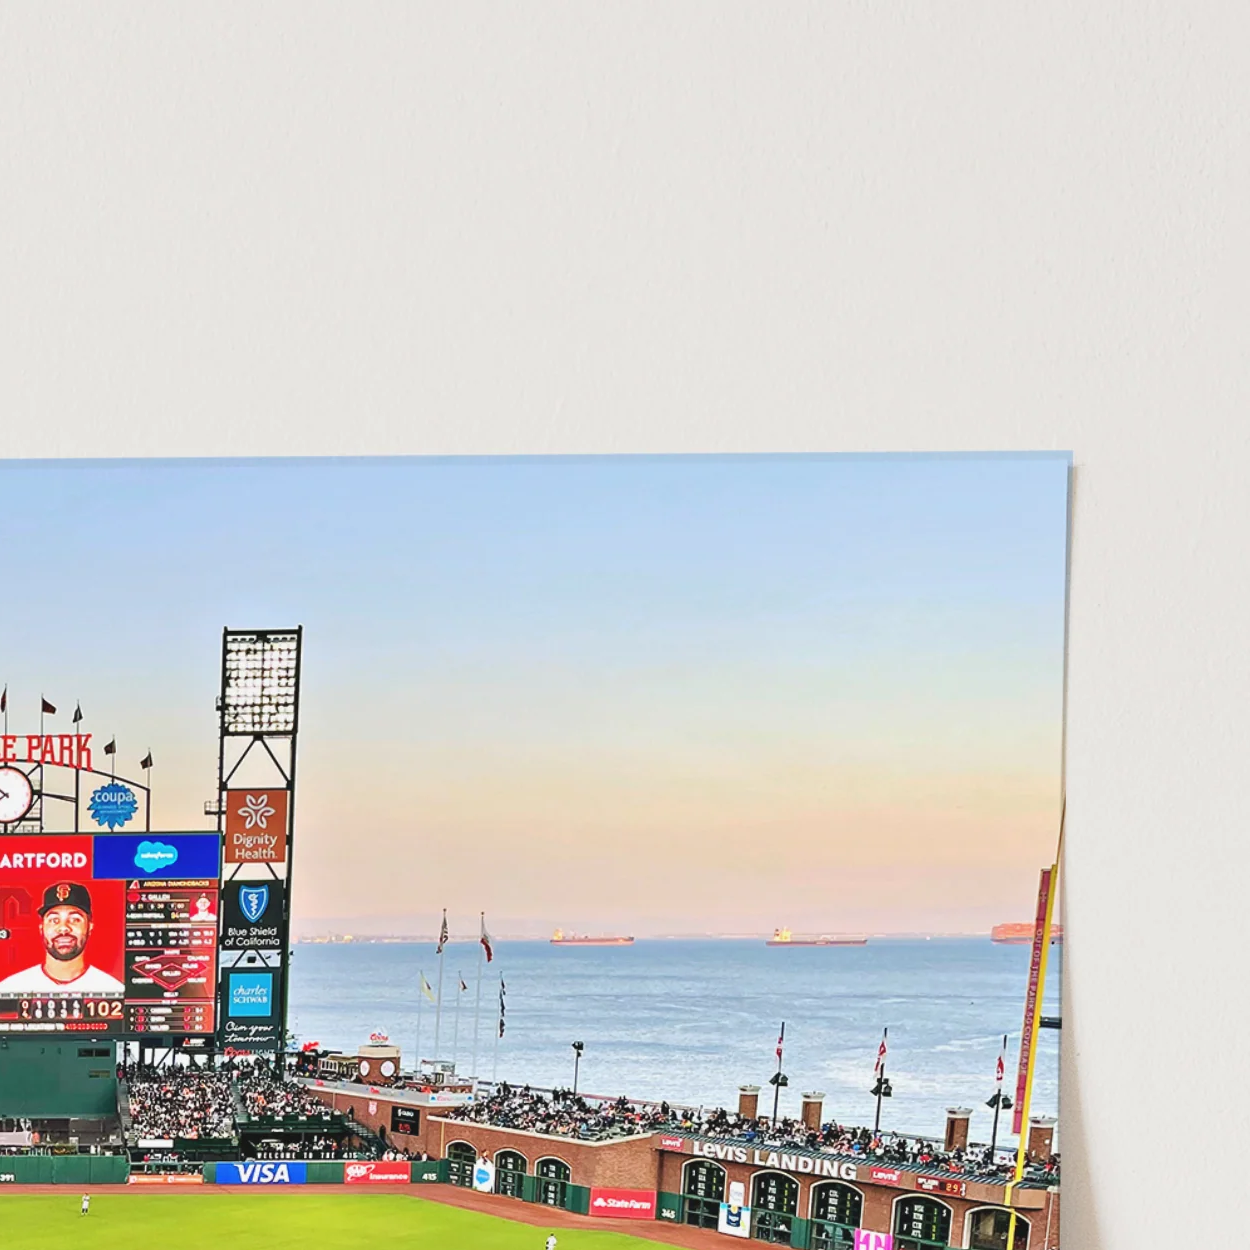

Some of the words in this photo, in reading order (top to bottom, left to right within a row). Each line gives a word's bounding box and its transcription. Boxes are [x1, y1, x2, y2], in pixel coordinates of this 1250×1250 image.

[26, 734, 93, 771] PARK
[95, 792, 133, 805] coupa
[233, 833, 278, 848] Dignity
[228, 927, 247, 936] Blue
[249, 927, 277, 936] Shield
[224, 937, 234, 946] of
[236, 937, 280, 946] California
[233, 984, 268, 996] charles
[233, 996, 268, 1004] SCHWAB
[87, 1001, 122, 1017] 102
[249, 1025, 274, 1036] your
[754, 1150, 857, 1181] LANDING
[0, 1174, 15, 1182] 391
[234, 1164, 290, 1183] VISA
[422, 1173, 437, 1181] 415
[607, 1198, 629, 1208] State
[630, 1199, 651, 1209] Farm
